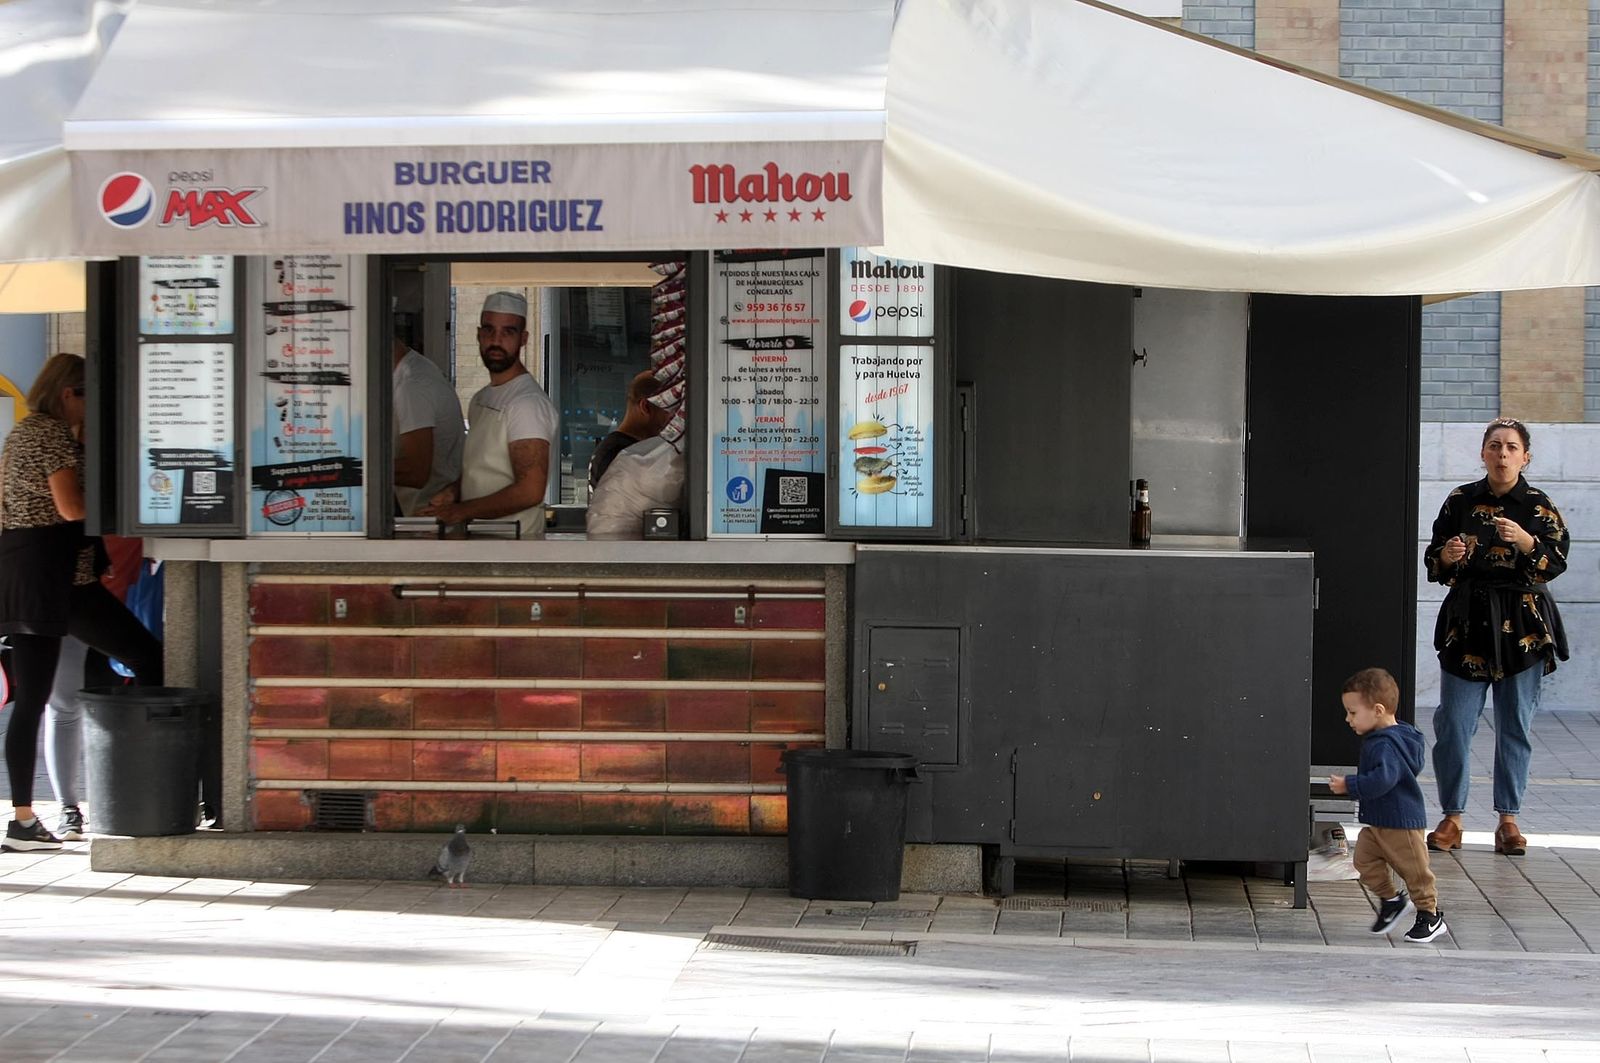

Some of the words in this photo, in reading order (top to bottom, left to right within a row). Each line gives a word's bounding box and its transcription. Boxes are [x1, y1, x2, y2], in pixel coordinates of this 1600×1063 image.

[168, 169, 214, 185] pepsi
[394, 160, 552, 186] BURGUER
[688, 161, 853, 204] Mahou
[160, 187, 262, 229] MAX
[343, 201, 426, 235] HNOS
[435, 199, 604, 234] RODRIGUEZ
[850, 260, 925, 279] Mahou
[851, 284, 890, 292] DESDE
[896, 284, 924, 292] 1890
[747, 303, 765, 312] 959
[767, 303, 779, 312] 36
[781, 303, 792, 312] 76
[794, 303, 805, 312] 57
[875, 303, 923, 320] pepsi
[746, 338, 784, 349] Horario
[851, 356, 905, 367] Trabajando
[906, 358, 923, 367] por
[855, 371, 861, 380] y
[863, 371, 884, 380] para
[886, 370, 920, 379] Huelva
[864, 389, 888, 404] desde
[889, 383, 908, 398] 1967
